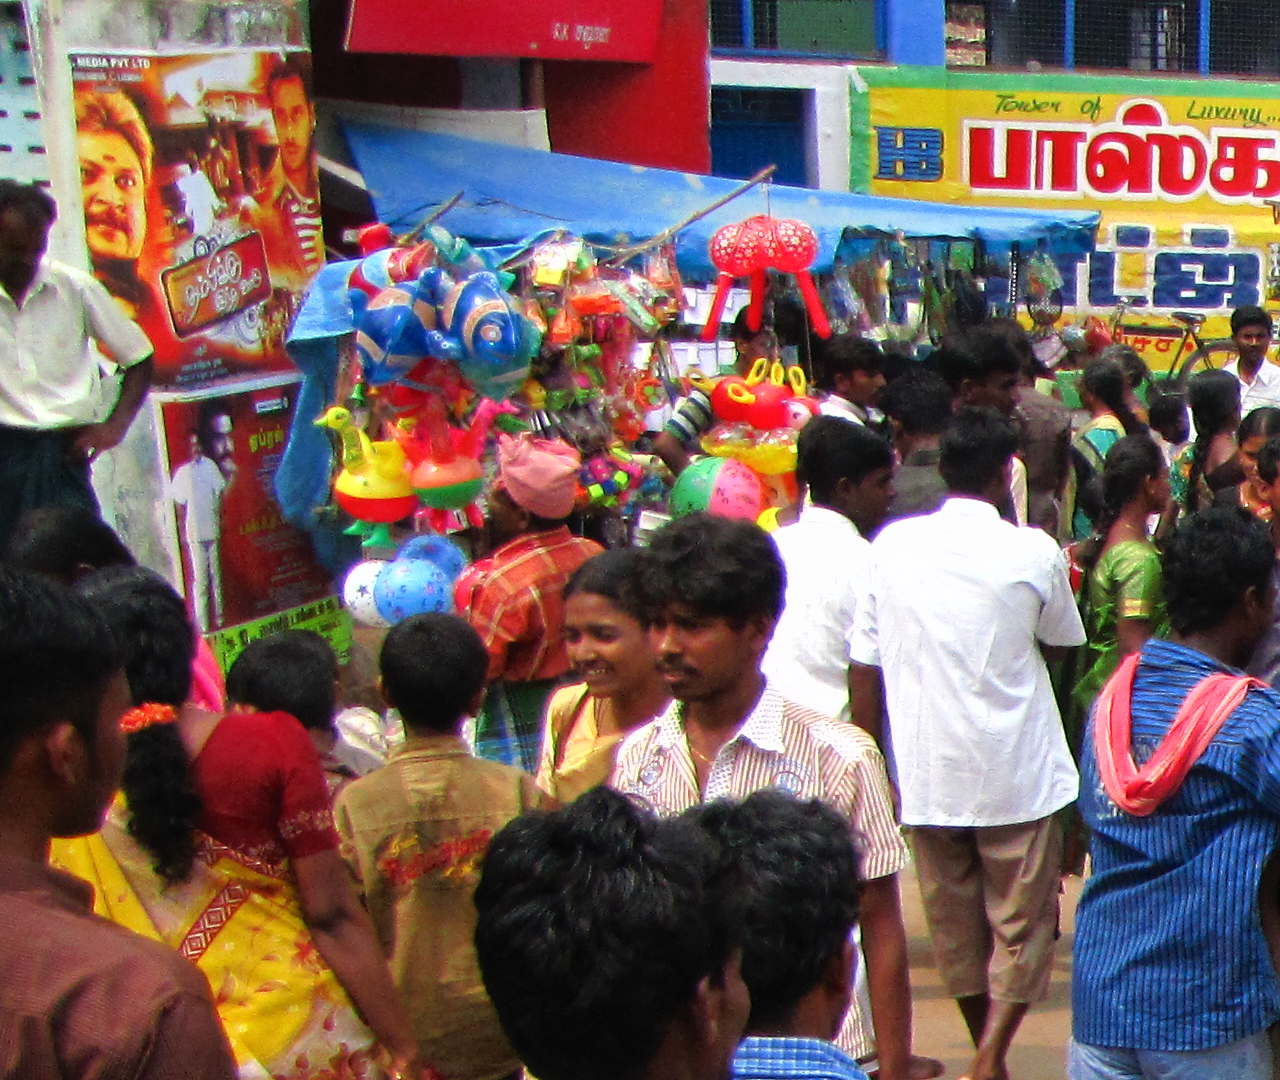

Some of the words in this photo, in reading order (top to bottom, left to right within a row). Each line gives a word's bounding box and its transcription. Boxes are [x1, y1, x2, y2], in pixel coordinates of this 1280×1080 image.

[77, 56, 109, 68] MEDIA
[110, 58, 129, 68] PVT
[132, 58, 151, 69] LTD
[995, 93, 1061, 114] Tower
[1081, 95, 1103, 122] of
